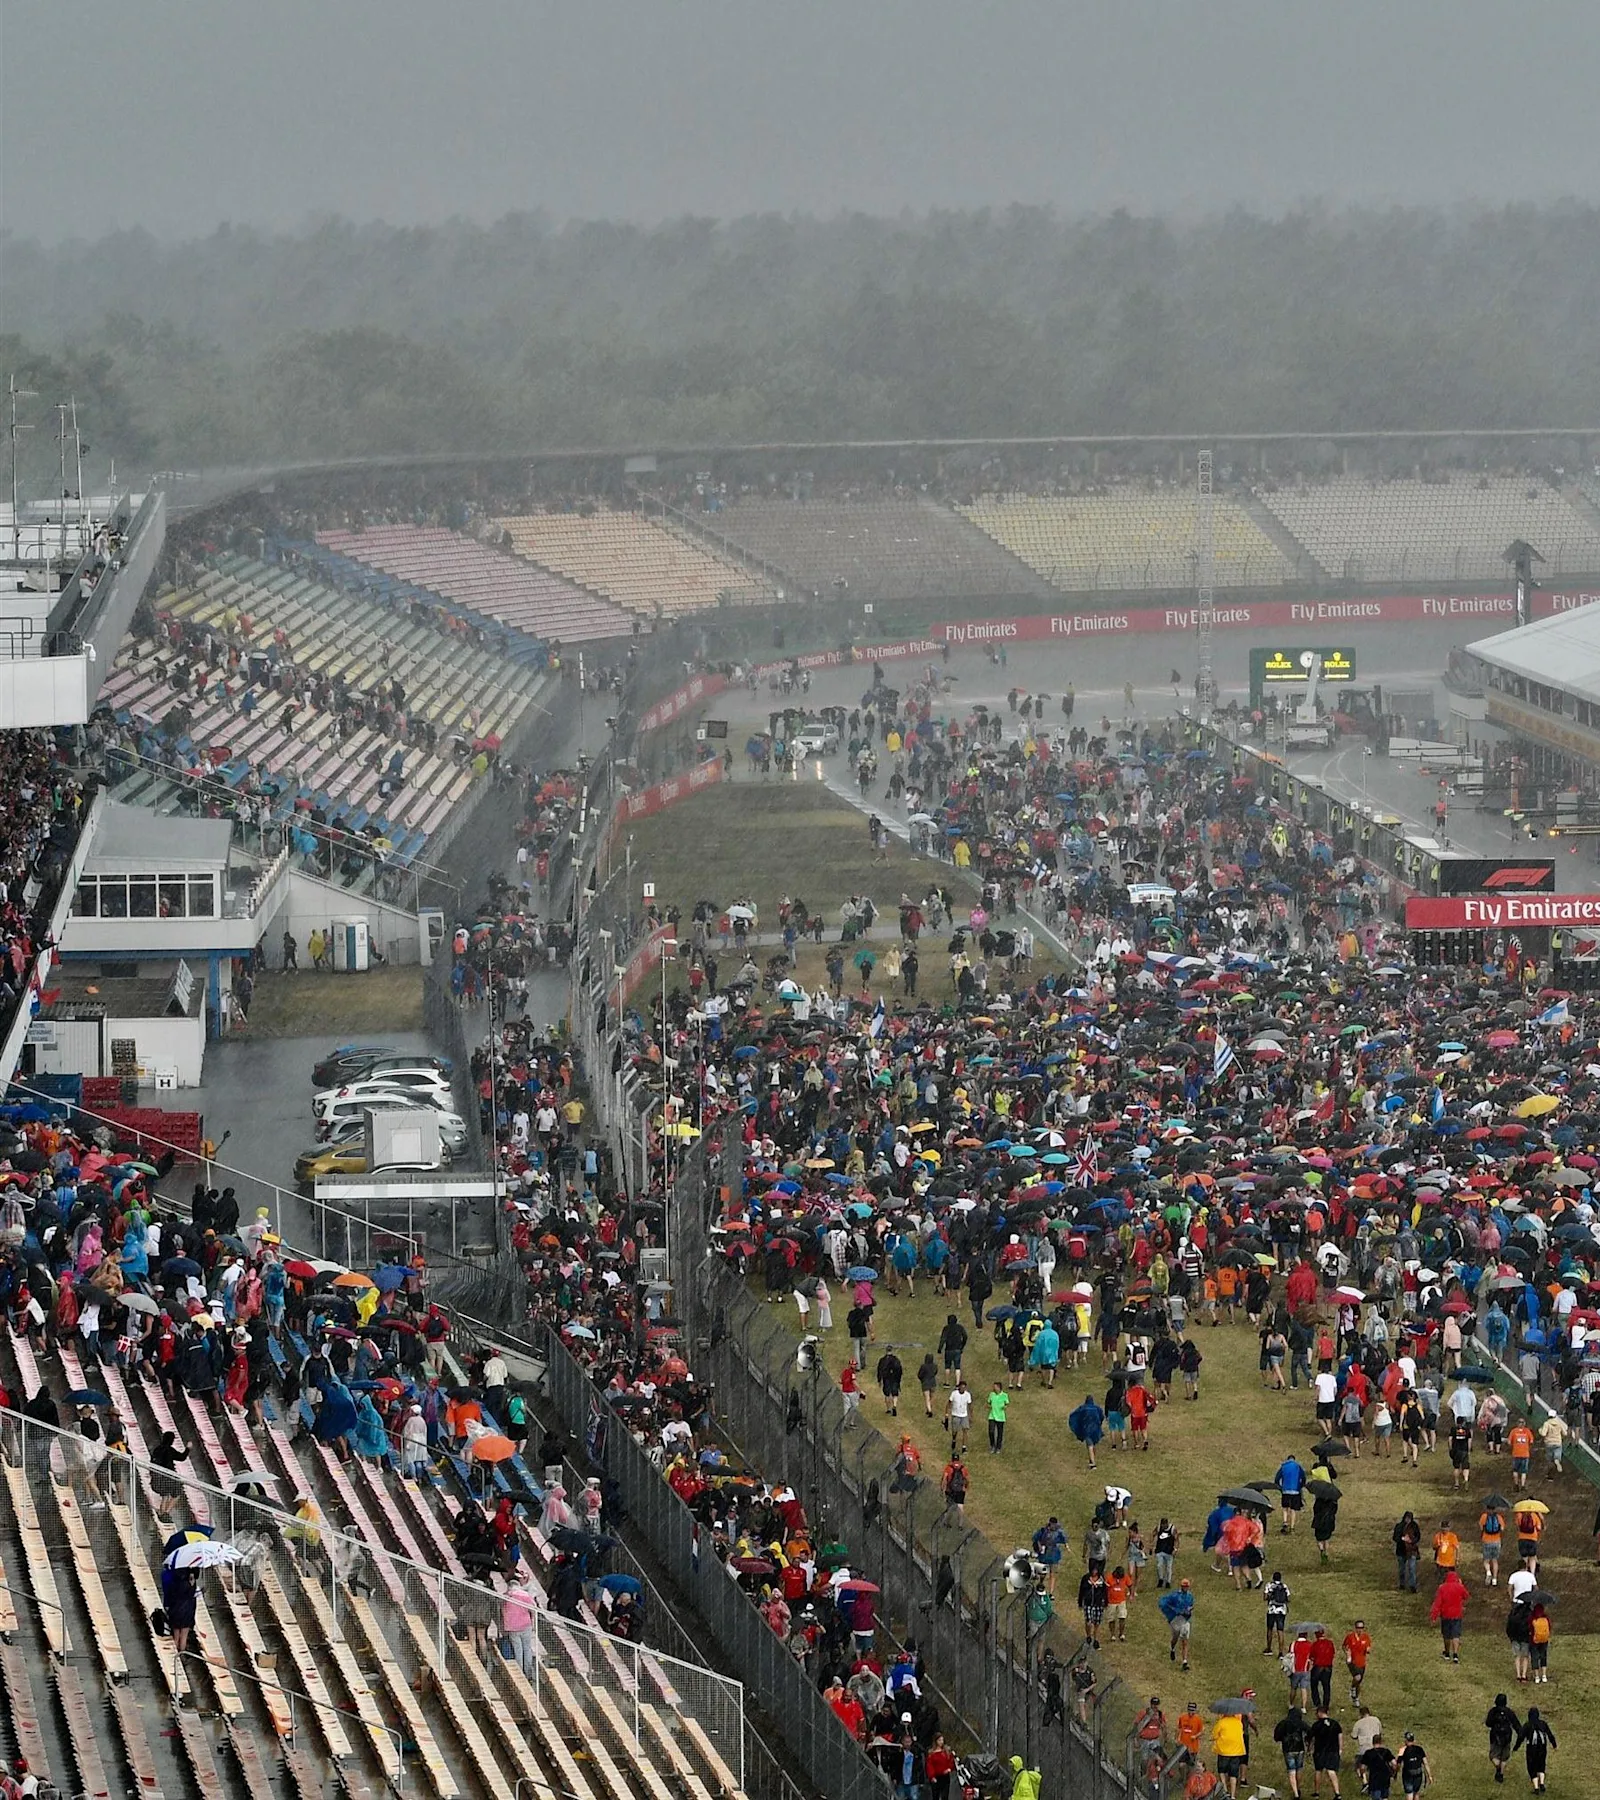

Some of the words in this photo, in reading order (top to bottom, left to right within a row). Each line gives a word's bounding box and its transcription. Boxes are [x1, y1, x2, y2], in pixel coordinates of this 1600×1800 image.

[1291, 604, 1314, 621] Fly
[1318, 602, 1381, 618] Emirates
[1423, 598, 1446, 616] Fly
[1450, 597, 1513, 612] Emirates
[1051, 618, 1071, 635] Fly
[1074, 614, 1128, 632] Emirates
[1165, 610, 1187, 628] Fly
[946, 626, 965, 643] Fly
[967, 622, 1017, 640] Emirates
[867, 647, 878, 661] Fly
[879, 644, 905, 658] Emirates
[1265, 661, 1292, 669] ROLEX
[1464, 900, 1501, 924] Fly
[160, 1079, 170, 1087] H
